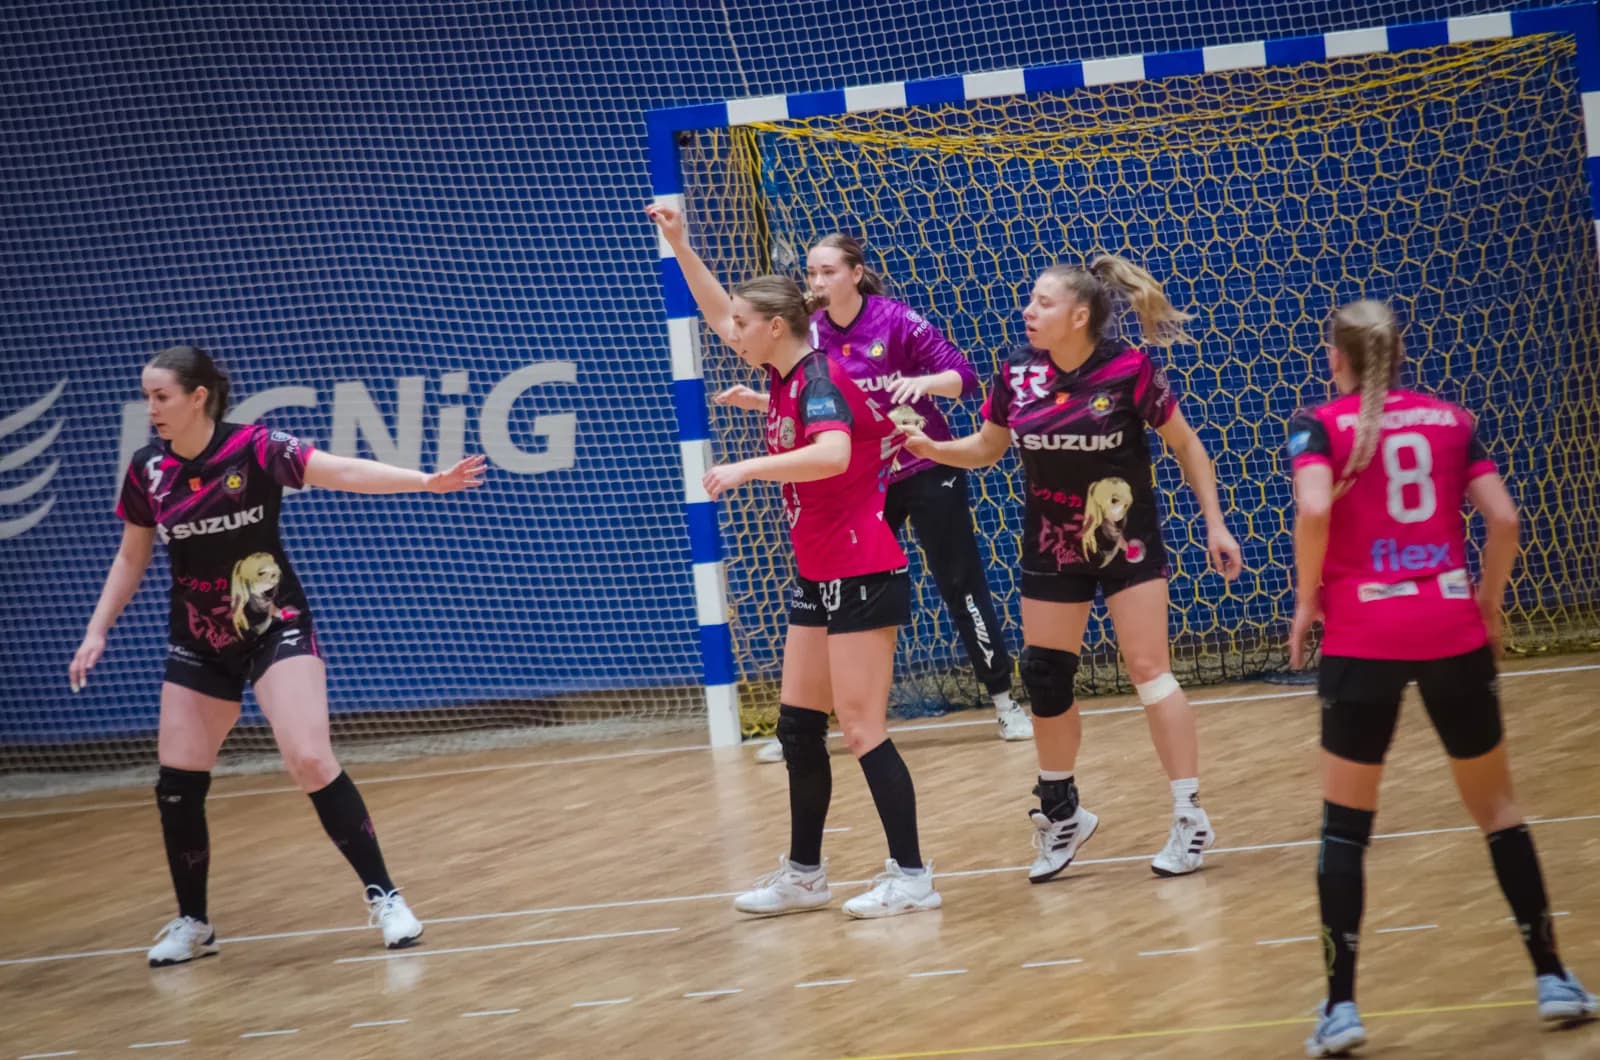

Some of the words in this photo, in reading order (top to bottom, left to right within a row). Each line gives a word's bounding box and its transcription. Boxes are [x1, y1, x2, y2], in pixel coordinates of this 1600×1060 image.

[116, 361, 577, 502] NiG
[1023, 431, 1123, 451] SUZUKI
[145, 456, 164, 493] 5
[1382, 432, 1436, 524] 8
[173, 505, 264, 541] SUZUKI
[1370, 538, 1452, 572] flex
